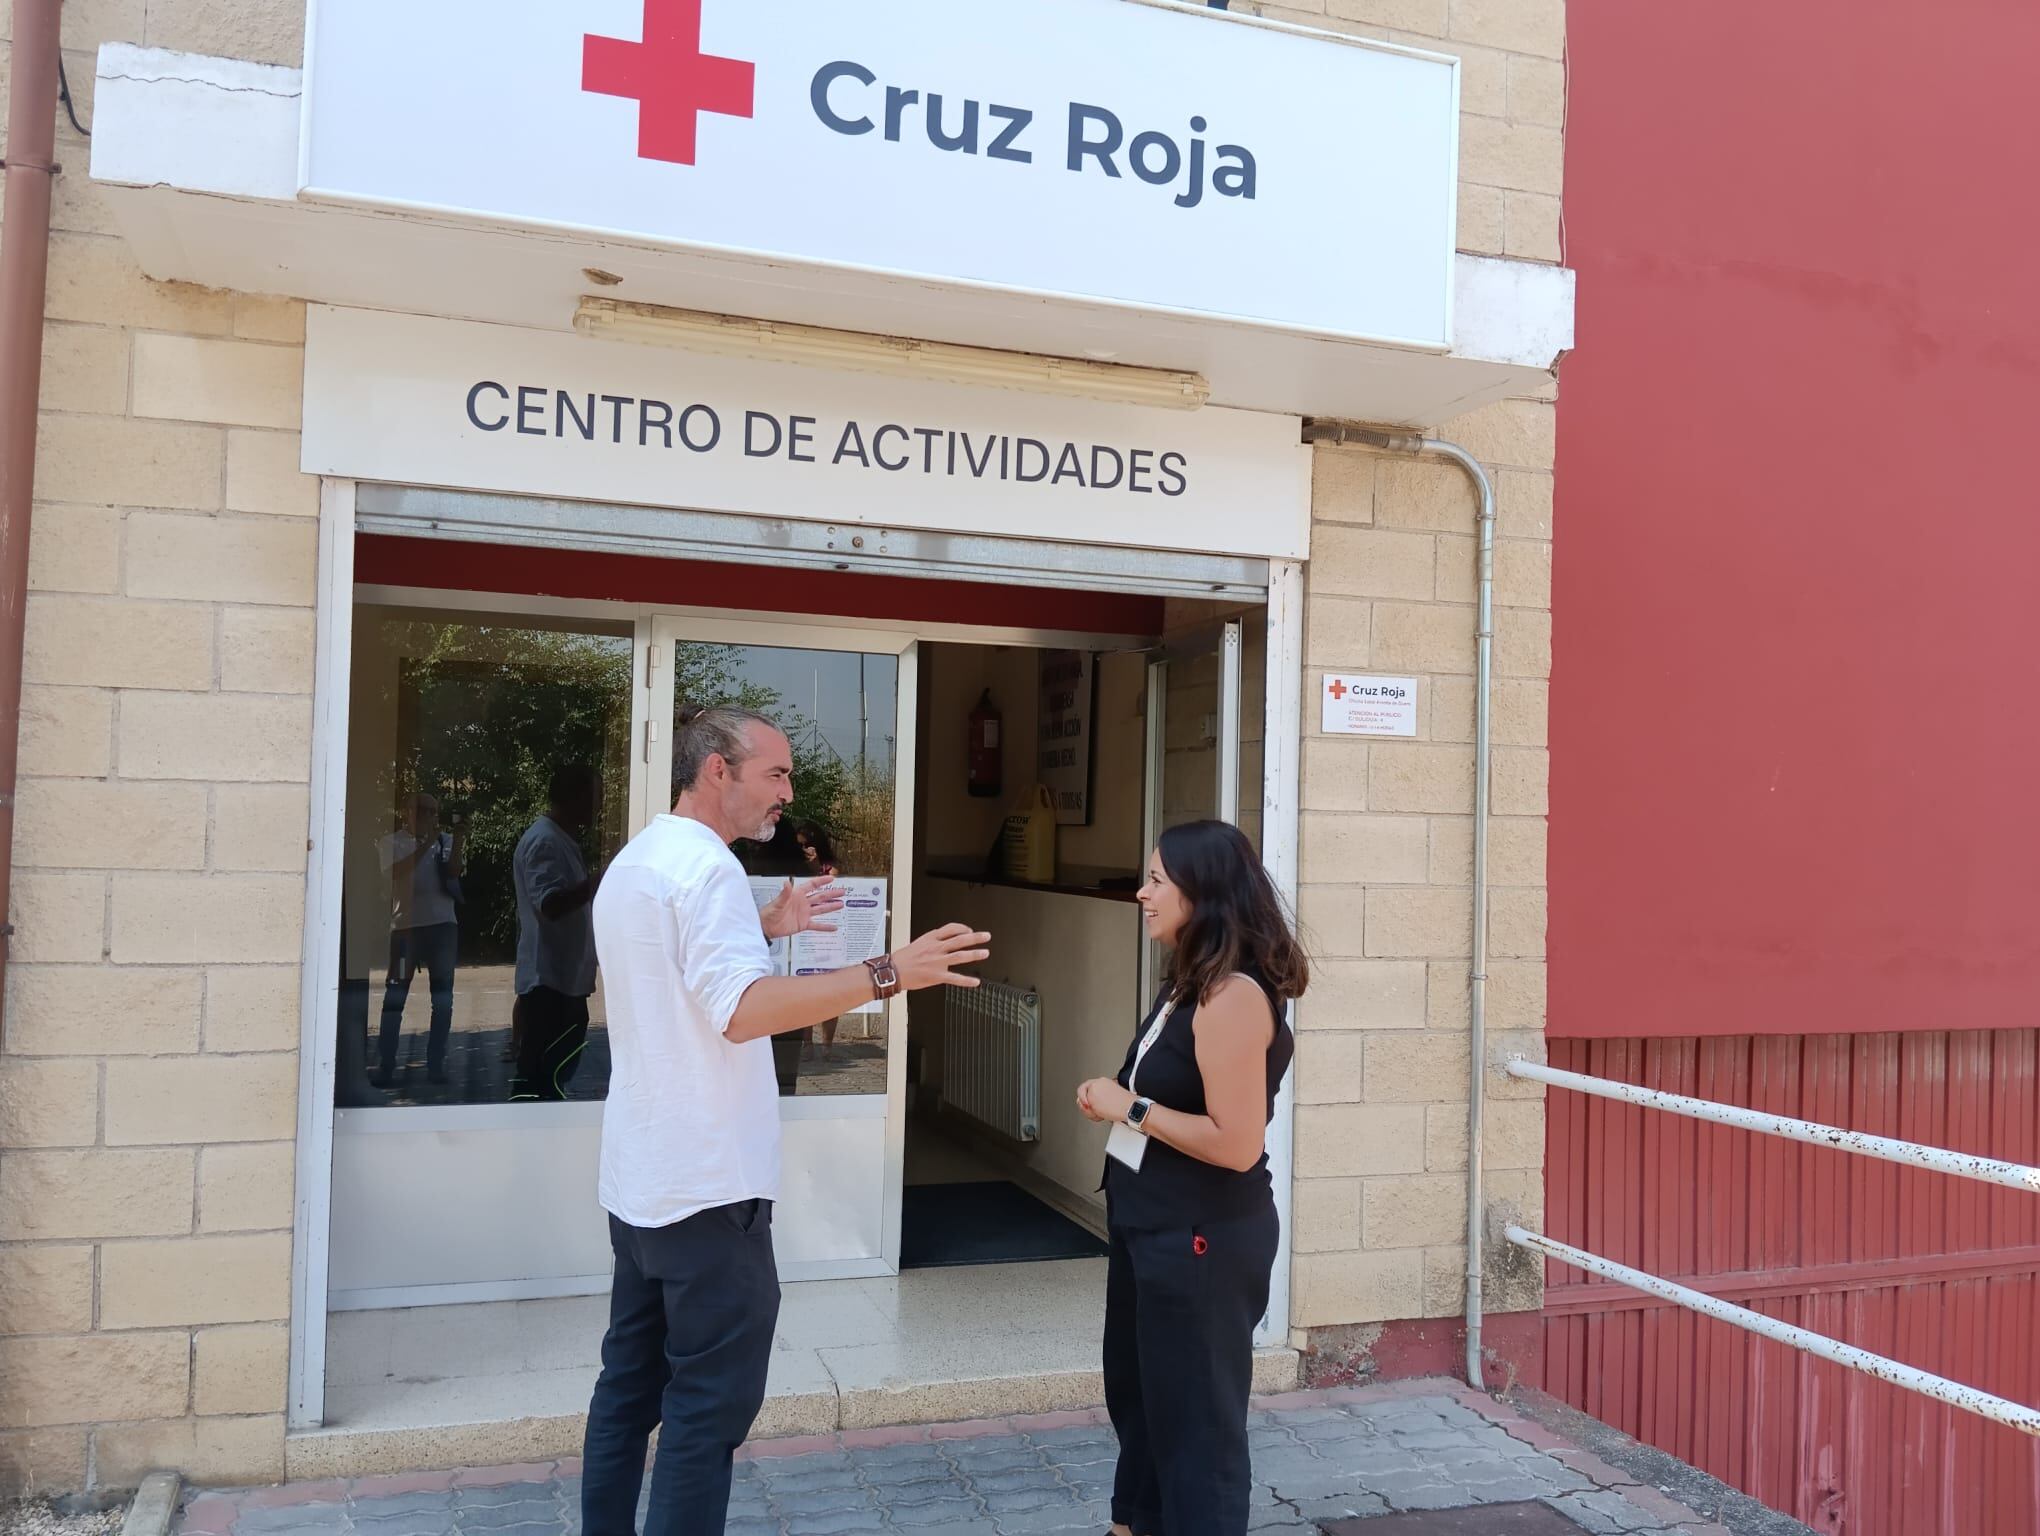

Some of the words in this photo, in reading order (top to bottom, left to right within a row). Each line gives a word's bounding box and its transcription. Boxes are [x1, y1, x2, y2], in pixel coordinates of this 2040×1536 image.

[810, 60, 1034, 164] Cruz
[1066, 101, 1258, 209] Roja
[466, 380, 721, 453] CENTRO
[743, 410, 816, 463] DE
[832, 420, 1188, 497] ACTIVIDADES
[1352, 685, 1378, 696] Cruz
[1381, 686, 1406, 699] Roja
